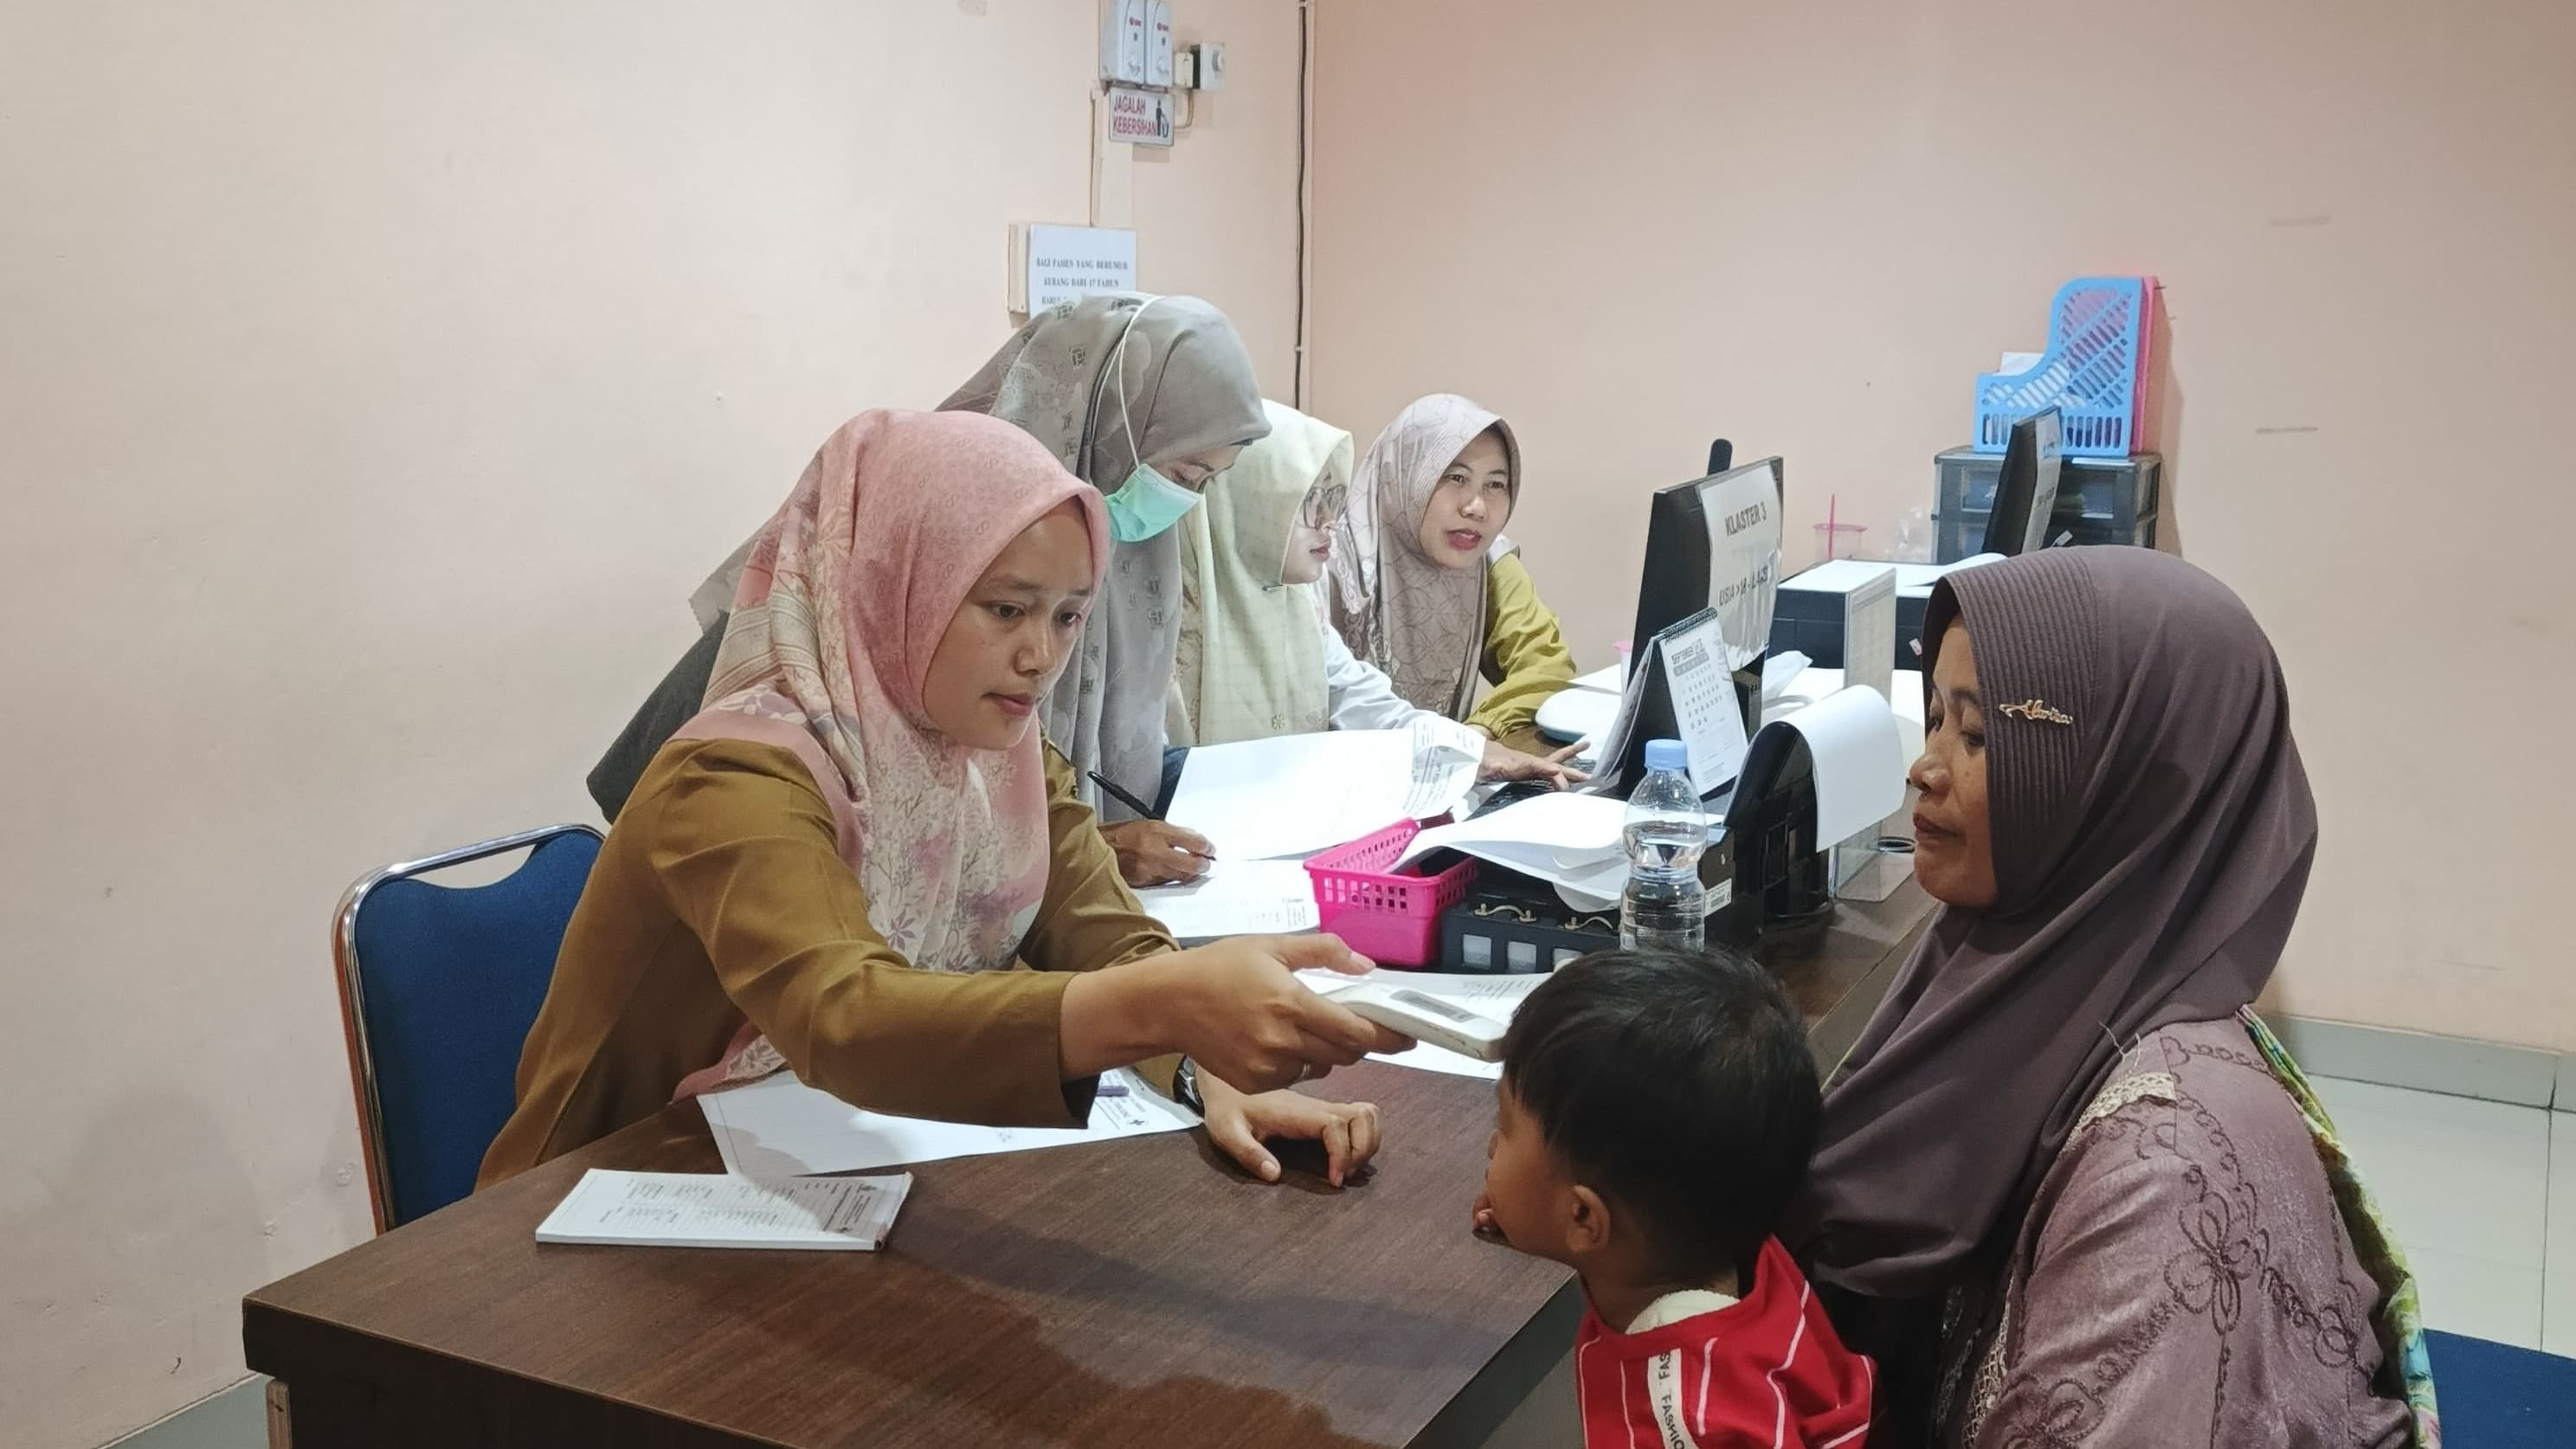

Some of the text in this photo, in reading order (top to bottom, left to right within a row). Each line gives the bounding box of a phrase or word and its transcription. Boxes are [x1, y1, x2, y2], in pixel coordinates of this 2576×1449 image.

[1114, 94, 1146, 115] JAGALAH
[1113, 115, 1156, 137] KEBERSIHAN
[1076, 260, 1094, 269] YANG
[1724, 501, 1767, 536] KLASTER 3
